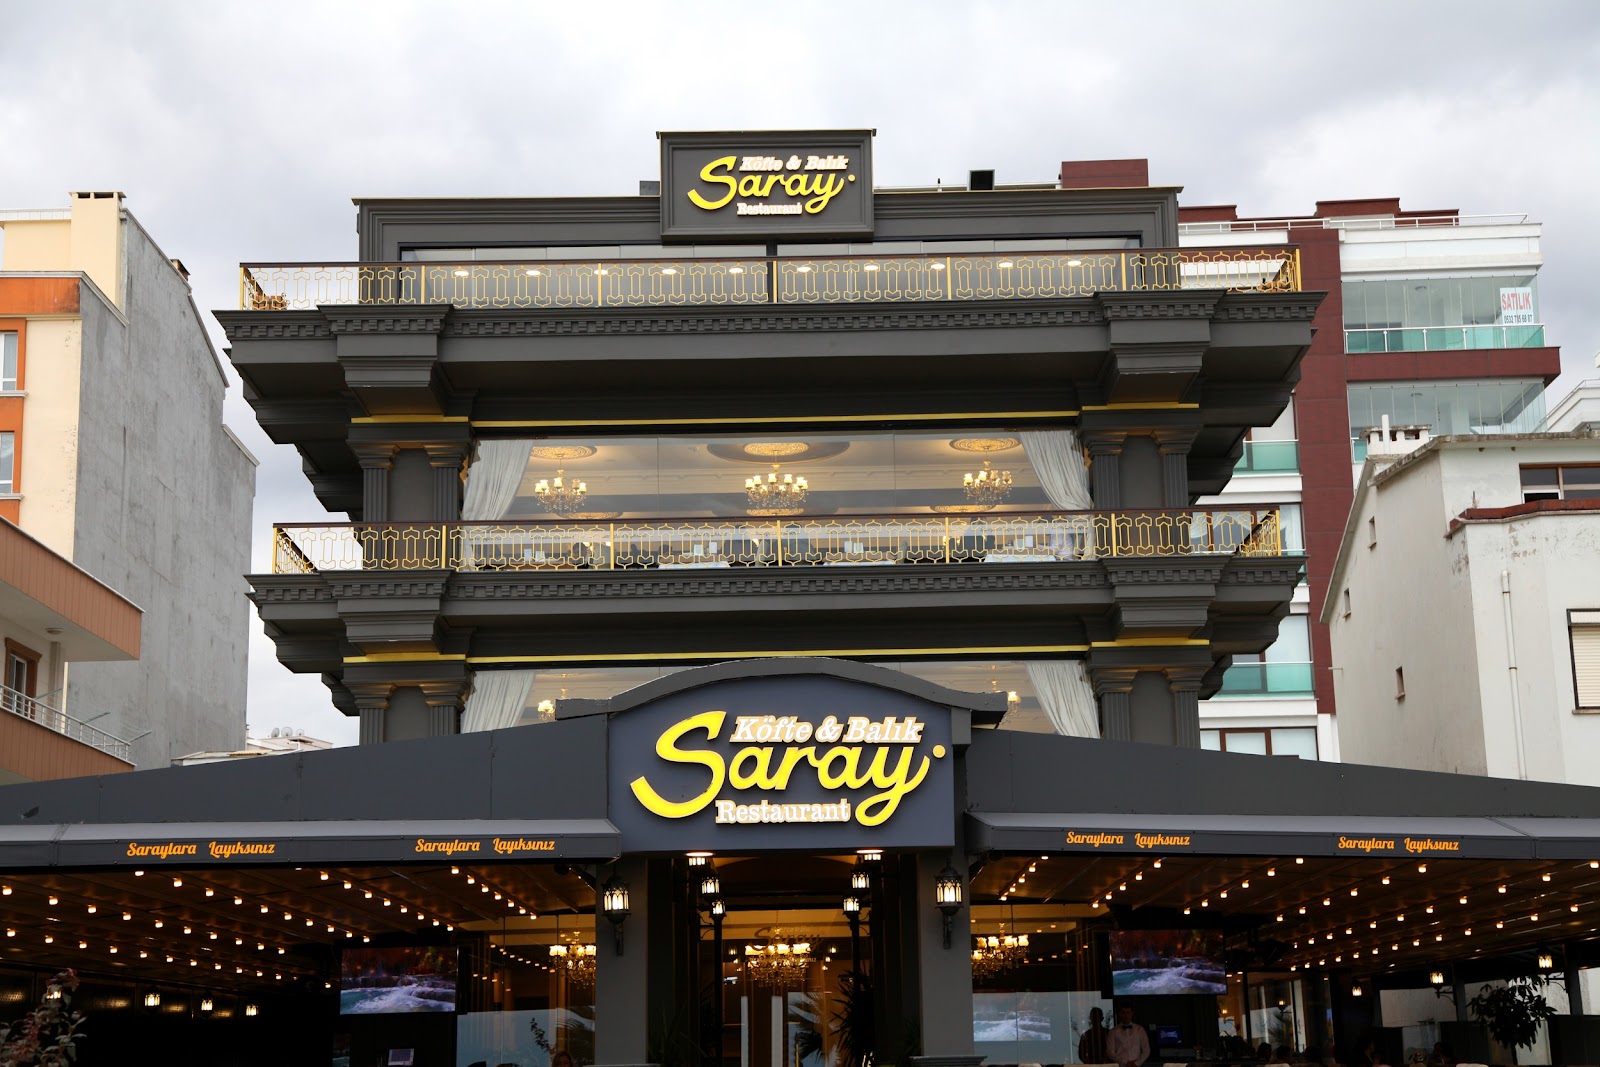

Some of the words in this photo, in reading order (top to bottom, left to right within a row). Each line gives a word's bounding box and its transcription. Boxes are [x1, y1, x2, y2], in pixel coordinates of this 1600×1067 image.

[739, 156, 783, 171] Köfte
[786, 155, 802, 170] &
[687, 156, 845, 214] Saray
[737, 202, 802, 215] Restaurant
[1501, 293, 1531, 310] SATILIK
[731, 716, 812, 742] Köfte
[815, 716, 843, 742] &
[843, 717, 924, 743] Balık
[630, 711, 930, 827] Saray
[716, 799, 851, 823] Restaurant
[415, 839, 480, 855] Saraylara
[1066, 831, 1124, 848] Saraylara
[1338, 836, 1395, 852] Saraylara
[127, 842, 197, 859] Saraylara
